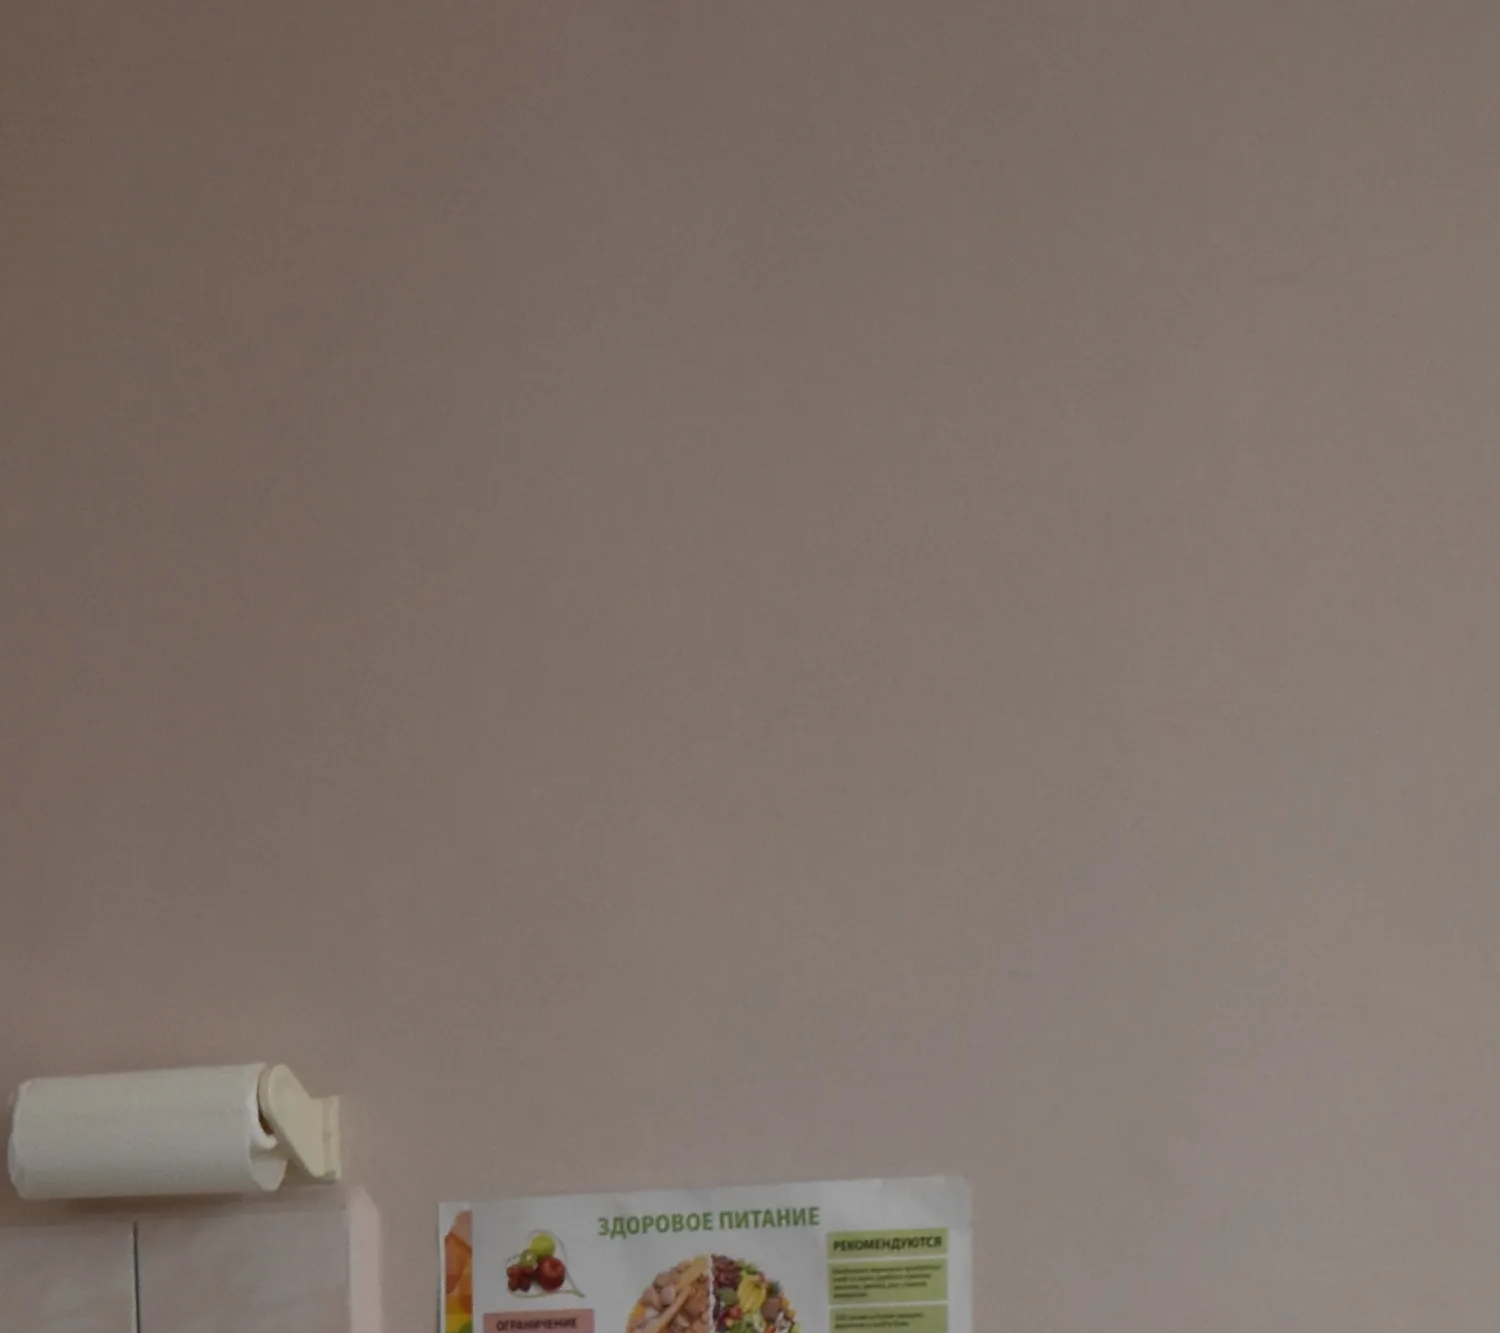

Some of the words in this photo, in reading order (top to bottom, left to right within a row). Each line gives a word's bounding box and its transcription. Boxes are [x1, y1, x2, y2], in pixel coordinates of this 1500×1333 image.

[598, 1212, 713, 1239] ЗДОРОВОЕ
[720, 1206, 820, 1230] ПИТАНИЕ
[833, 1236, 943, 1251] РЕКОМЕНДУЮТСЯ
[496, 1317, 577, 1332] ОГРАНИЧЕНИЕ
